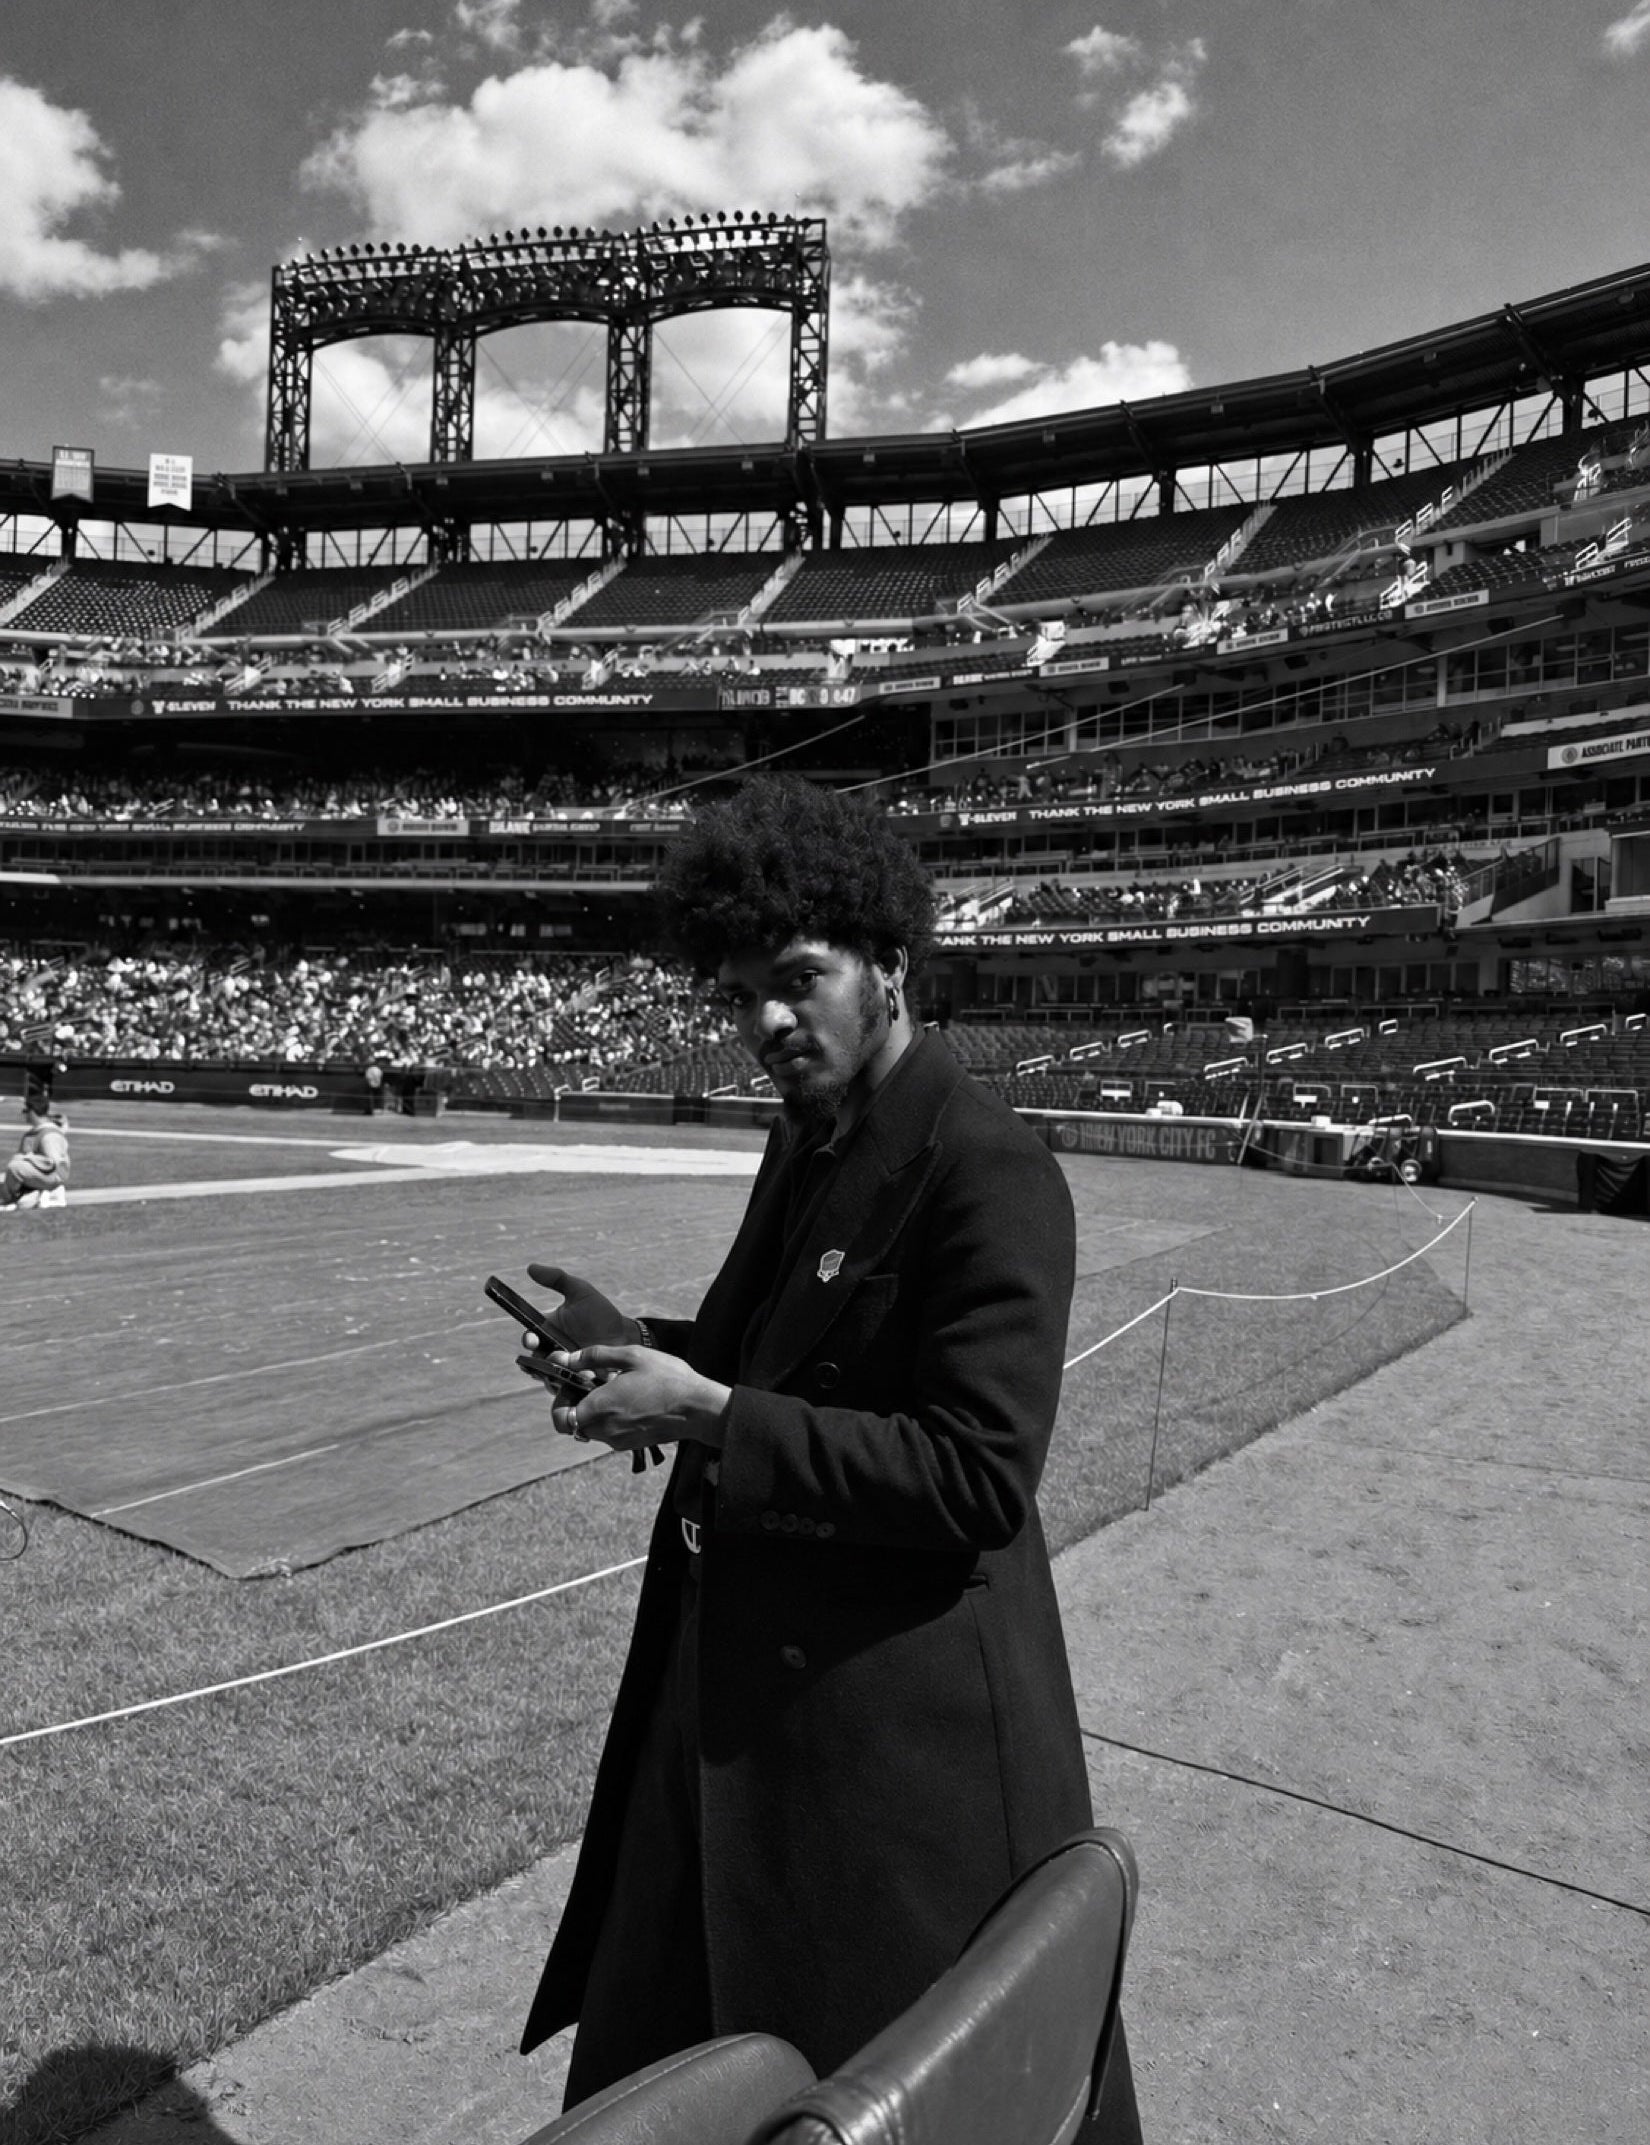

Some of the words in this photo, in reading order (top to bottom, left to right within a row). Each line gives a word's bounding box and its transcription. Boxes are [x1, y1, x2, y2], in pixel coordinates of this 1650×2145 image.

[228, 700, 281, 711] THANK
[284, 699, 316, 710] THE
[320, 698, 358, 709] NEW
[361, 698, 404, 708] YORK
[409, 697, 463, 708] SMALL
[467, 696, 549, 707] BUSINESS
[553, 694, 653, 706] COMMUNITY
[1029, 807, 1079, 820] THANK
[1083, 805, 1112, 816] THE
[1116, 802, 1152, 813] NEW
[1155, 799, 1196, 811] YORK
[1199, 792, 1250, 806] SMALL
[1253, 781, 1331, 799] BUSINESS
[1335, 768, 1435, 789] COMMUNITY
[980, 934, 1012, 945] THE
[1015, 933, 1055, 945] NEW
[1059, 932, 1103, 943] YORK
[1107, 929, 1161, 942] SMALL
[1165, 923, 1252, 939] BUSINESS
[1257, 915, 1371, 933] COMMUNITY
[110, 1080, 175, 1093] ETIHAD
[249, 1084, 318, 1098] ETIHAD
[1117, 1124, 1156, 1156] YORK
[1160, 1126, 1194, 1160] CITY
[1196, 1128, 1217, 1160] FC
